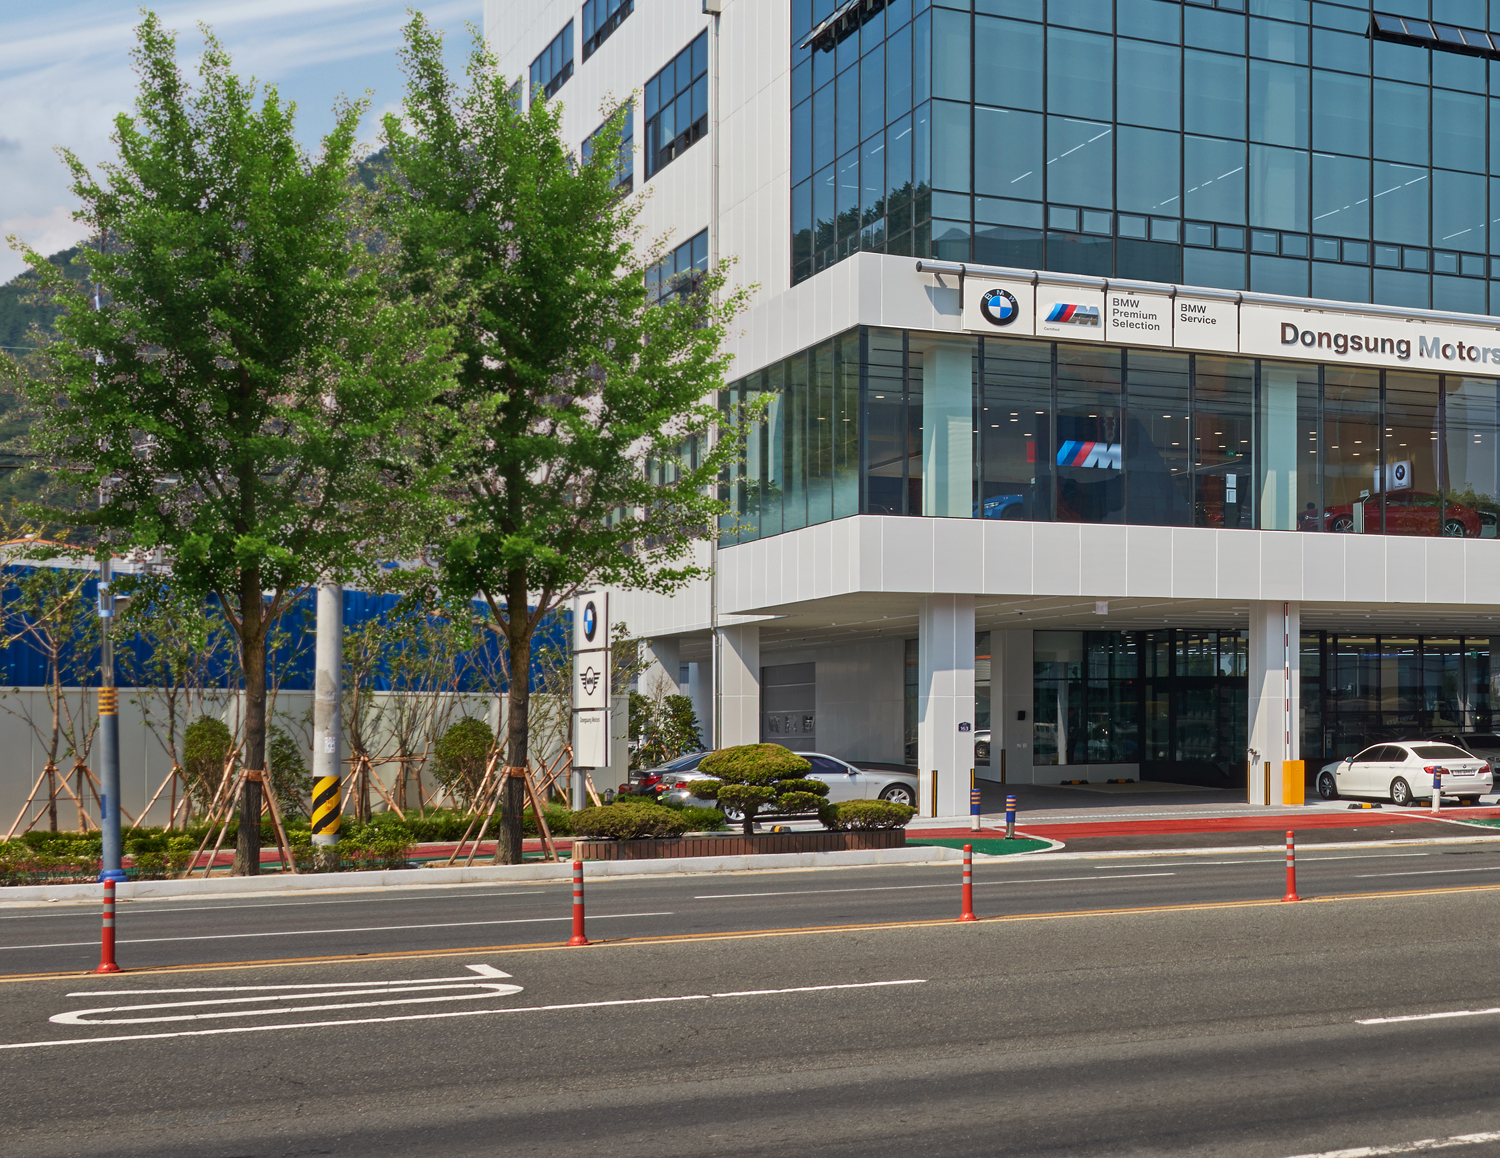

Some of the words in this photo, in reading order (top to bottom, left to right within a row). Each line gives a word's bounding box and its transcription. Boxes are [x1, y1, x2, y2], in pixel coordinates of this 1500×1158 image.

[1112, 298, 1140, 309] BMW
[1180, 303, 1207, 314] BMW
[1112, 308, 1158, 321] Premium
[1180, 313, 1217, 325] Service
[1112, 318, 1161, 331] Selection
[1280, 322, 1411, 360] Dongsung
